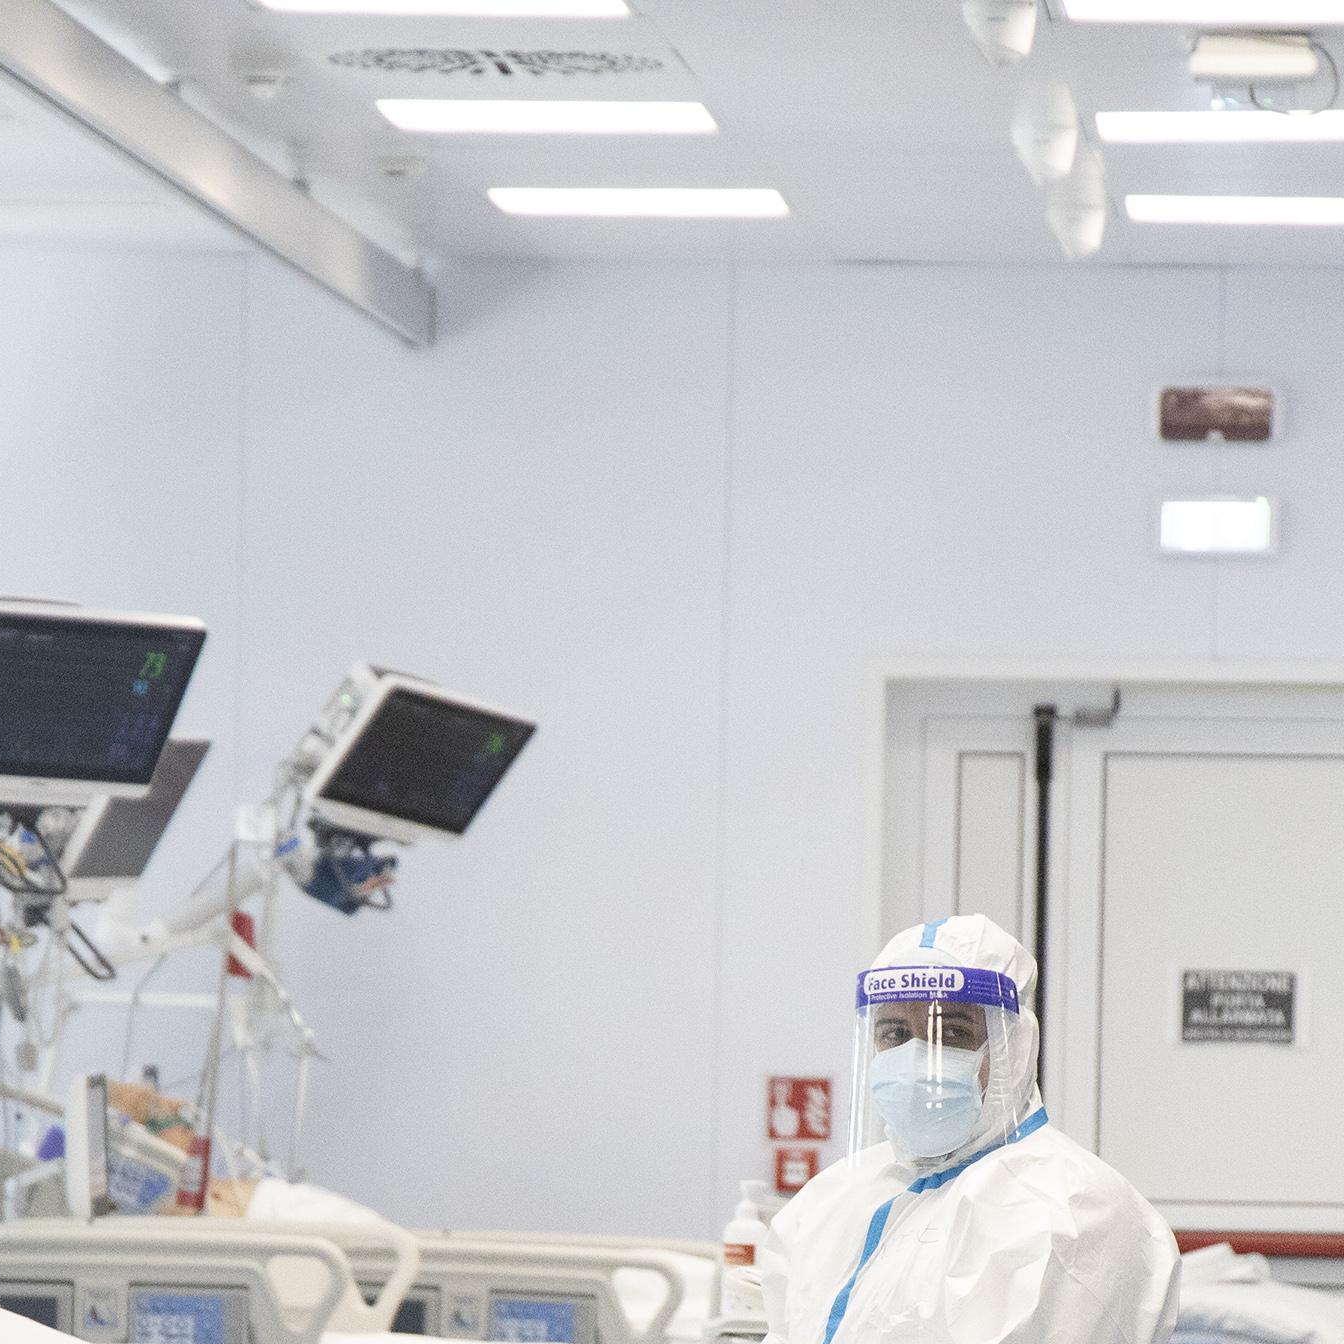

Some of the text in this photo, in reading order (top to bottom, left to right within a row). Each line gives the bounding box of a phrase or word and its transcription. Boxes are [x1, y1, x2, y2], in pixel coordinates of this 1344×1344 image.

[868, 973, 956, 991] Face Shield
[870, 993, 898, 1001] Protective
[929, 990, 948, 999] Mk
